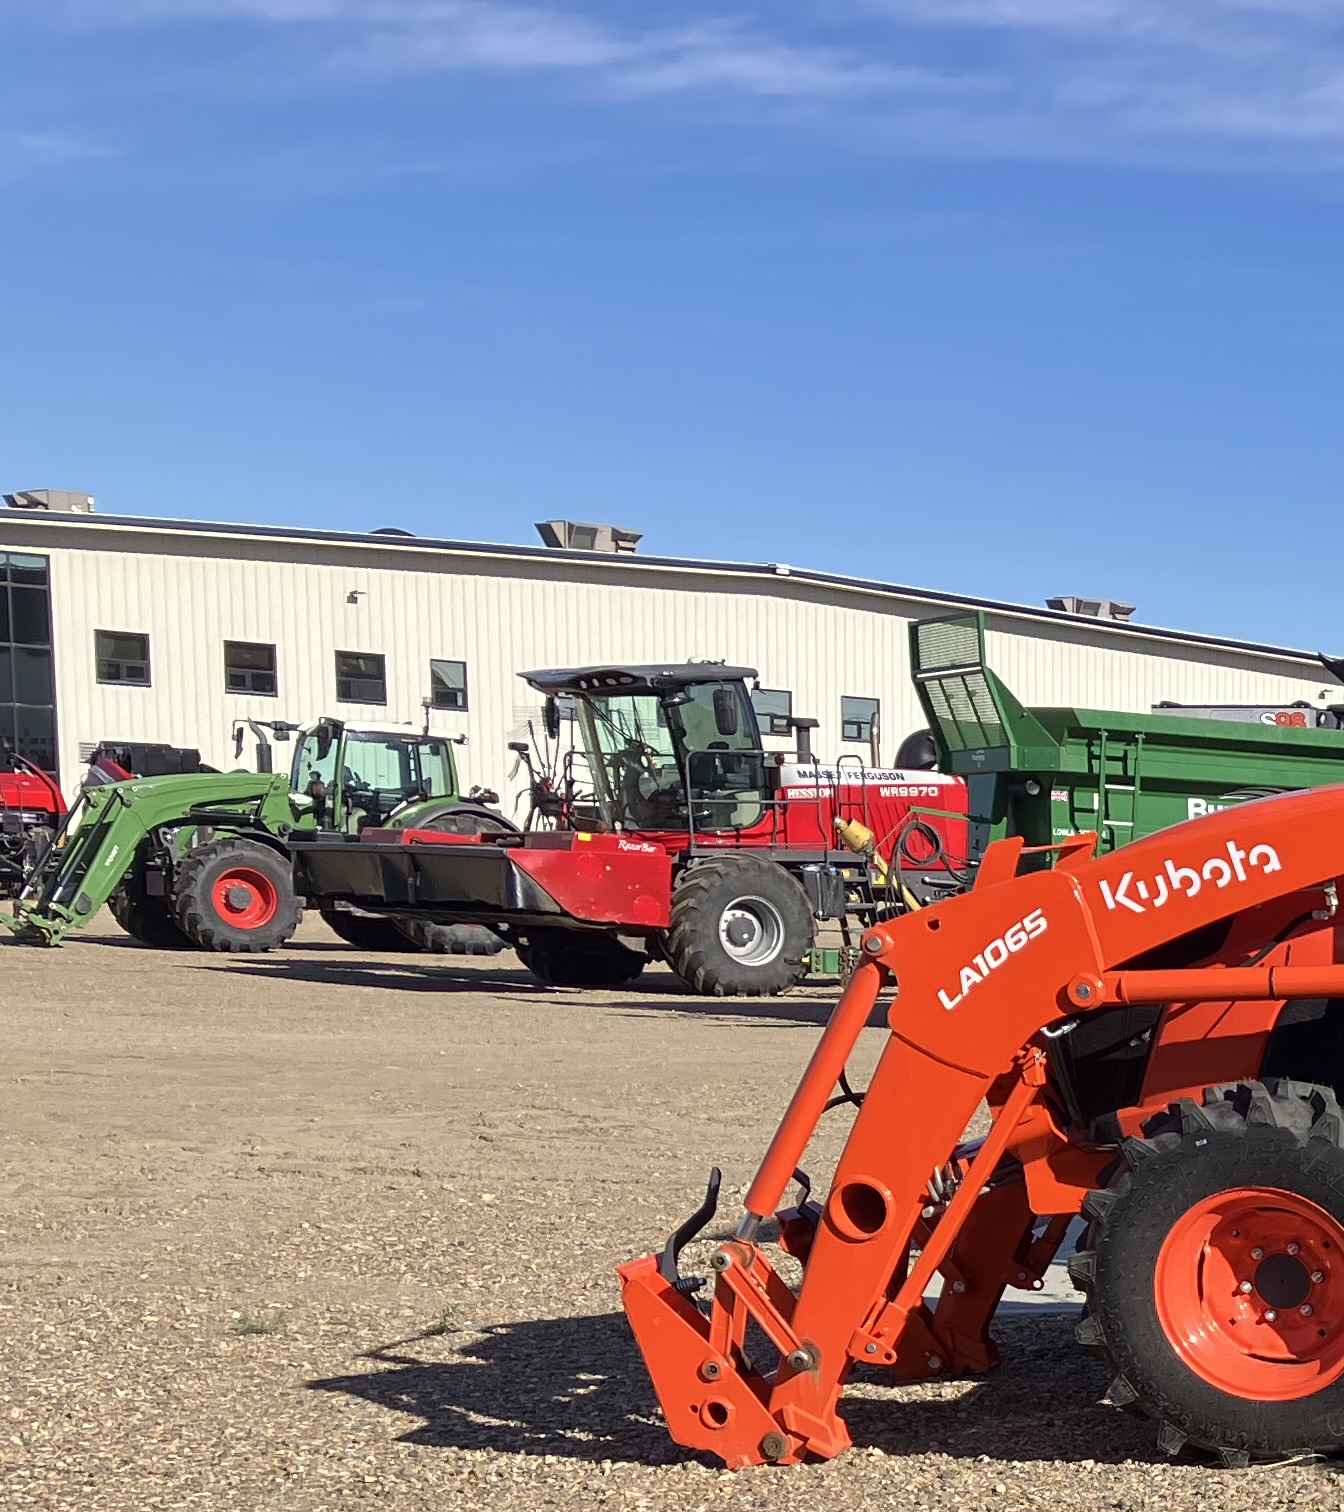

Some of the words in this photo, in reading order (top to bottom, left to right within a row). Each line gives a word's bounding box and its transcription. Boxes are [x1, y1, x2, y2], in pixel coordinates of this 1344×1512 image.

[848, 771, 906, 781] FERGUSON
[879, 786, 939, 798] WR9970
[1099, 840, 1282, 913] Kubota
[936, 907, 1049, 1011] LA1065
